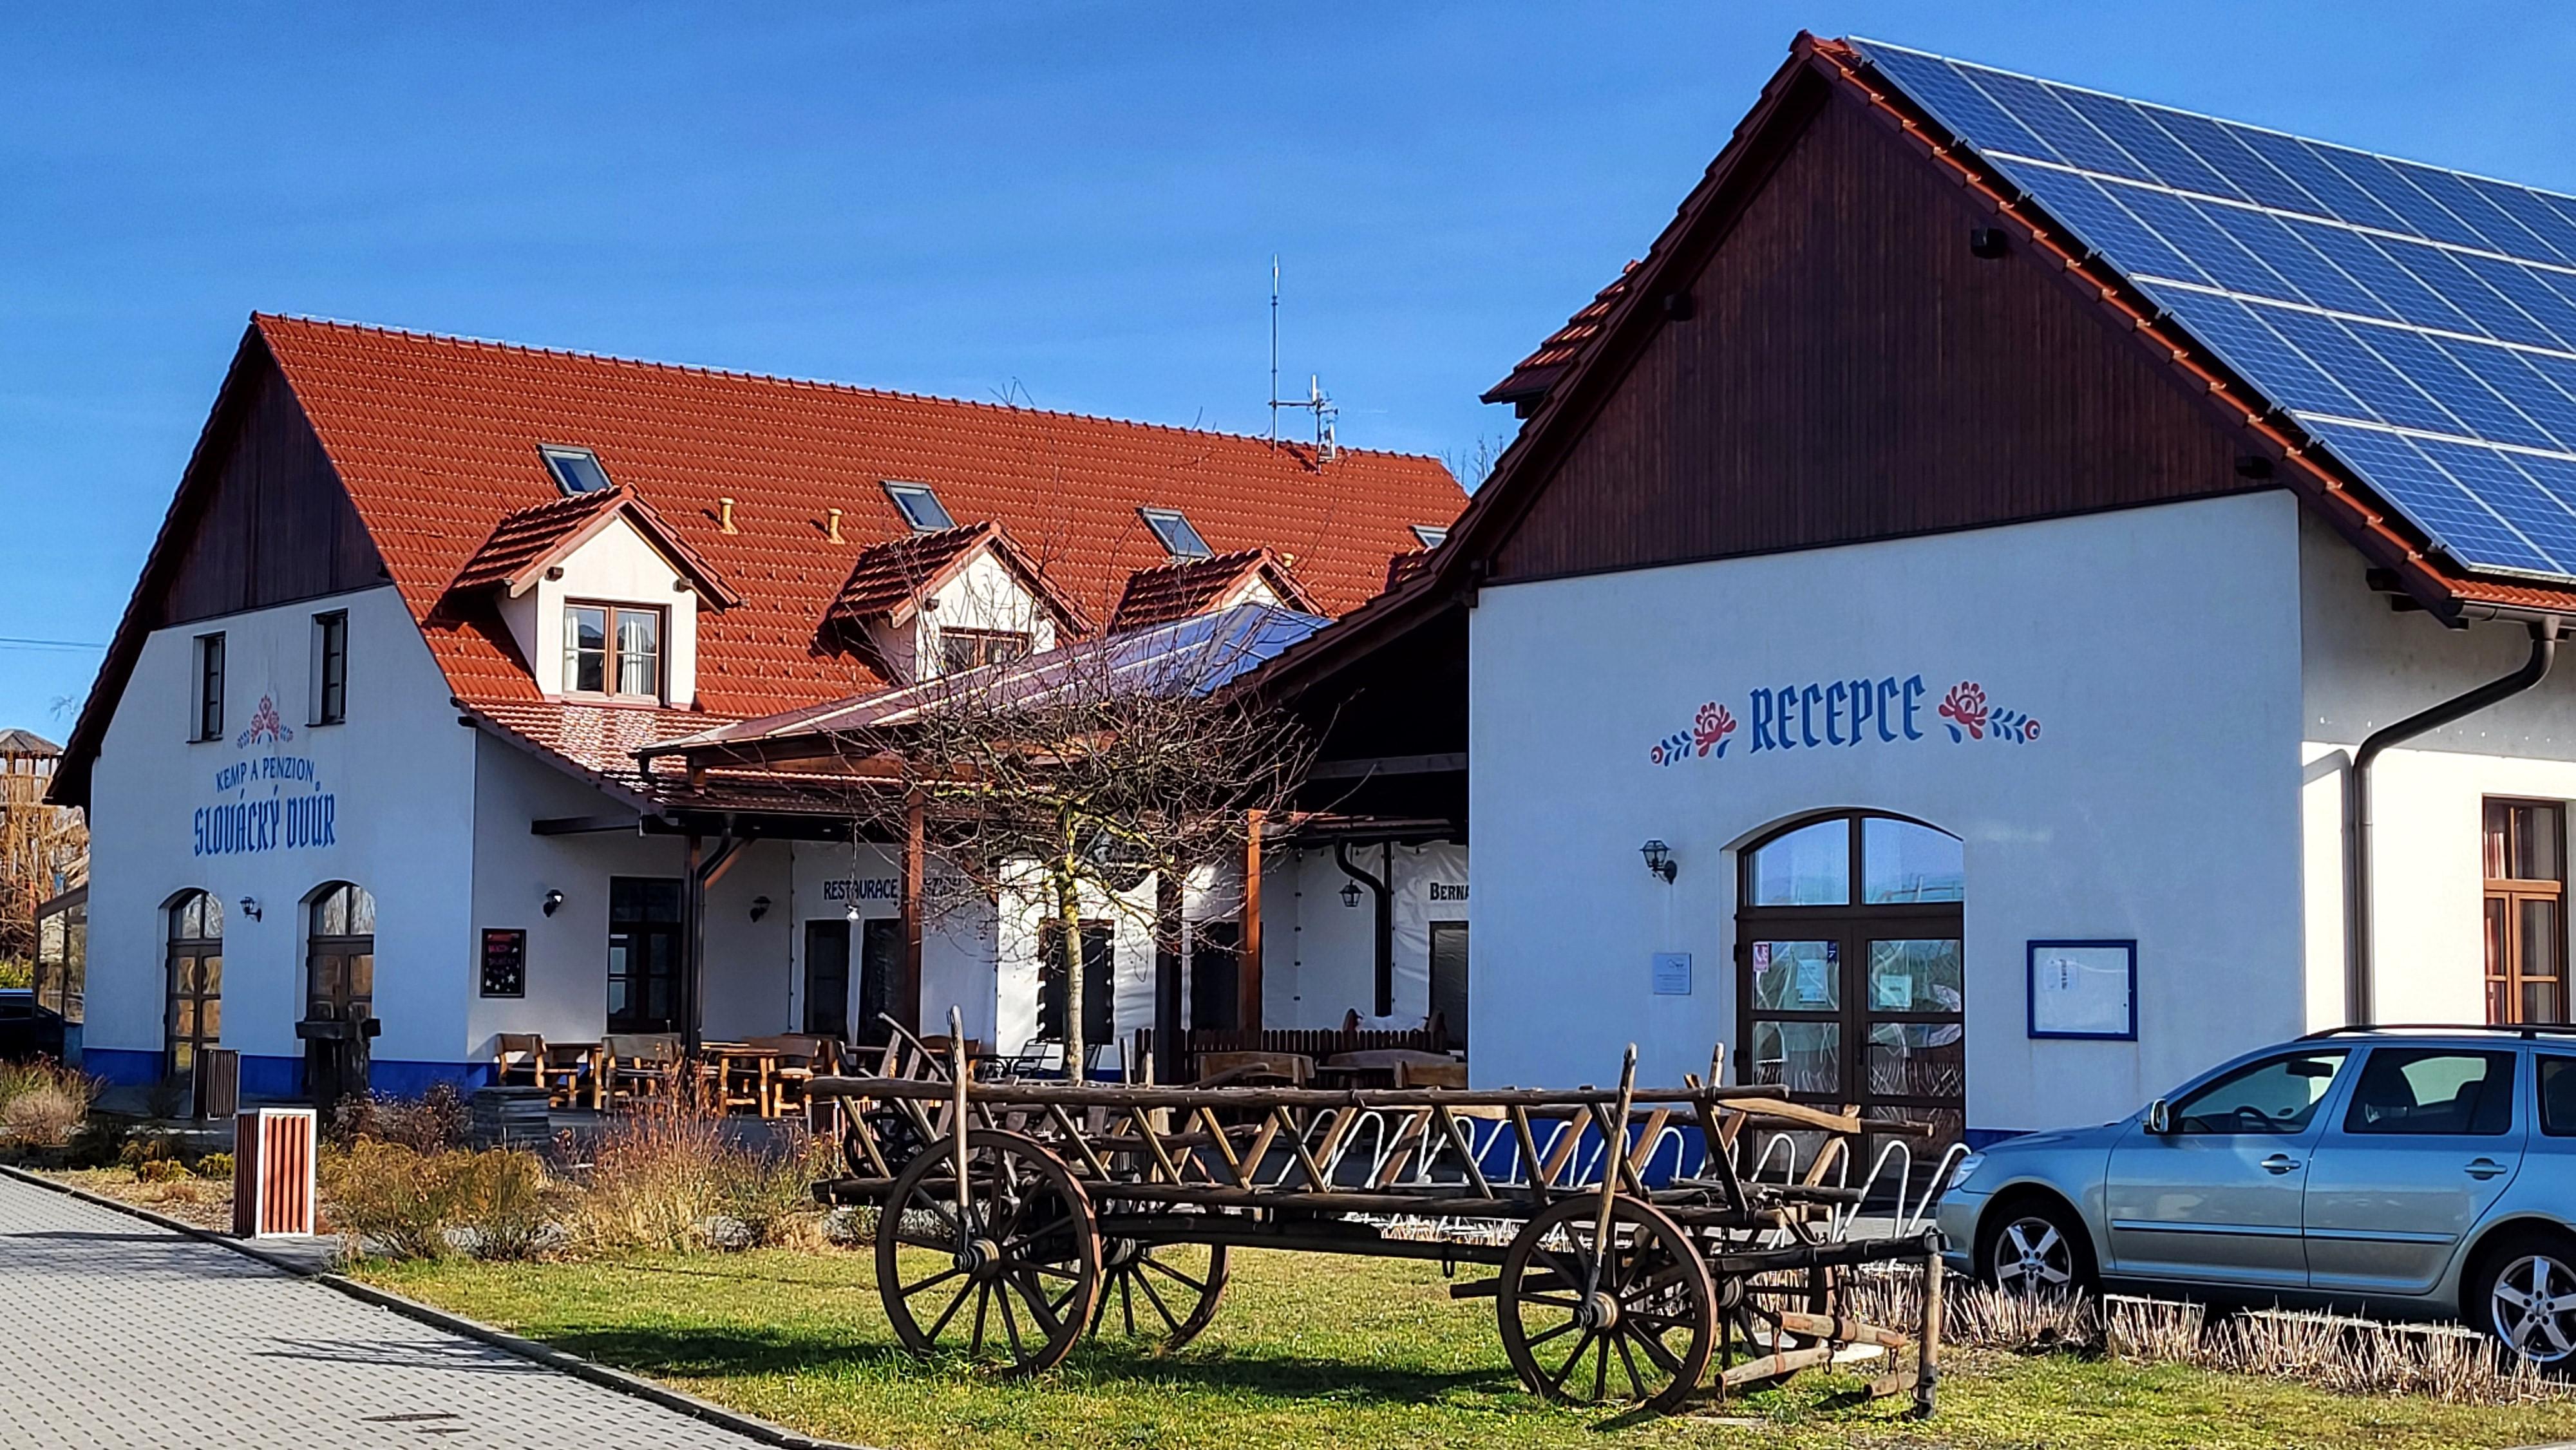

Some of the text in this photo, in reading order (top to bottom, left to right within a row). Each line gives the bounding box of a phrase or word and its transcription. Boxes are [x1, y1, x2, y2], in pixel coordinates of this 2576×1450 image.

[1750, 674, 1926, 754] RECEPCE
[216, 756, 314, 793] KEMP A PENZION
[824, 878, 898, 900] RESTAURACE
